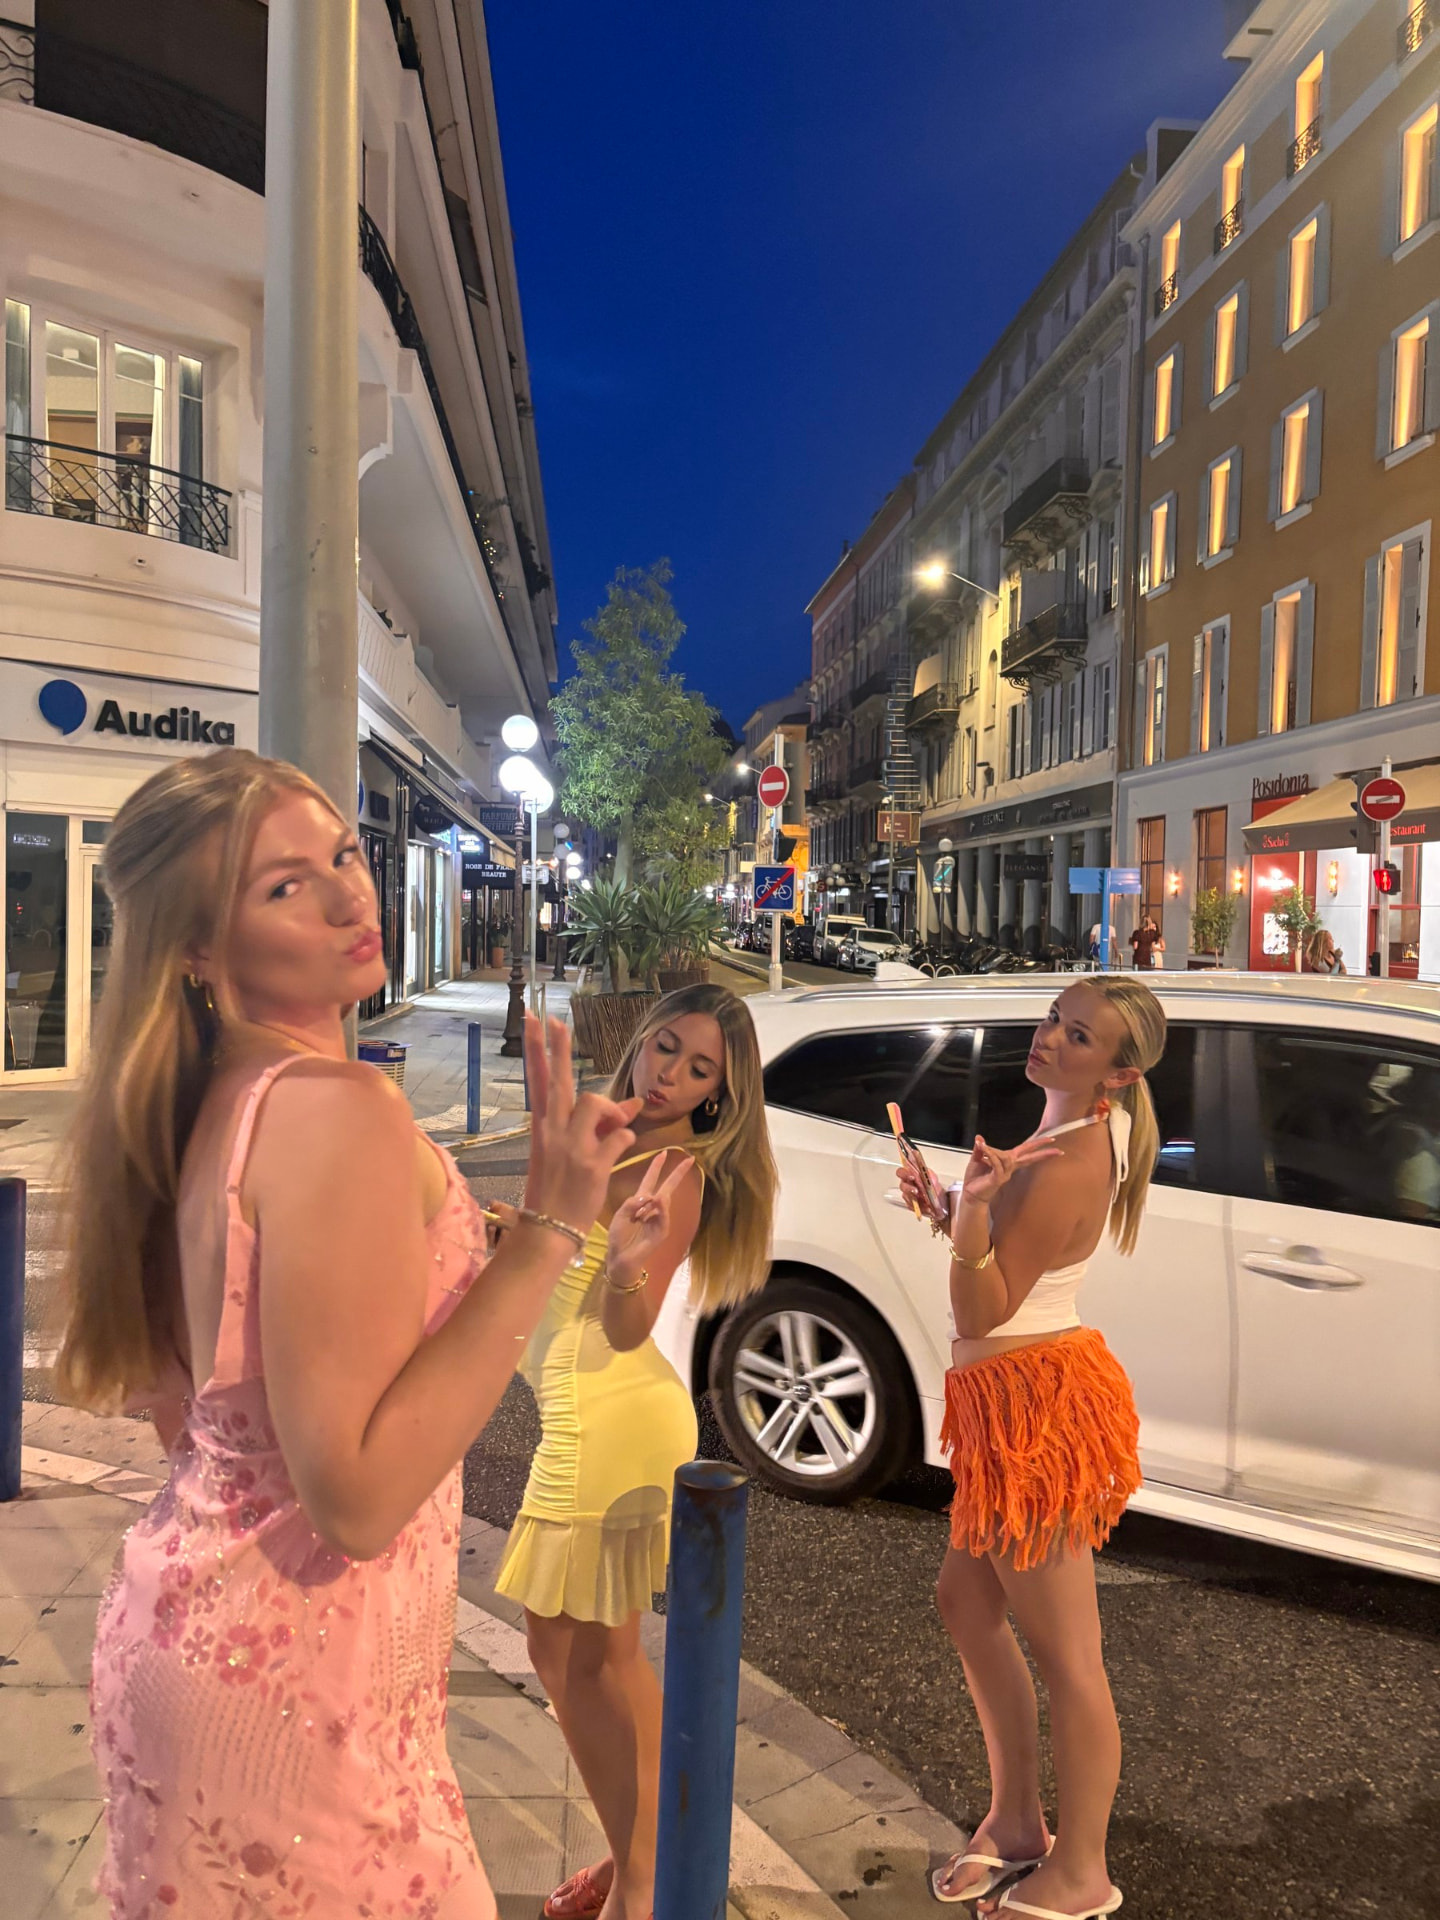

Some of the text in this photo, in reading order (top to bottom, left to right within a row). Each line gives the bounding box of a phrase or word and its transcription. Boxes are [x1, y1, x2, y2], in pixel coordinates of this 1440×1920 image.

[94, 699, 235, 746] Audika
[1252, 772, 1309, 799] Posidonia
[1390, 823, 1427, 837] estaurant
